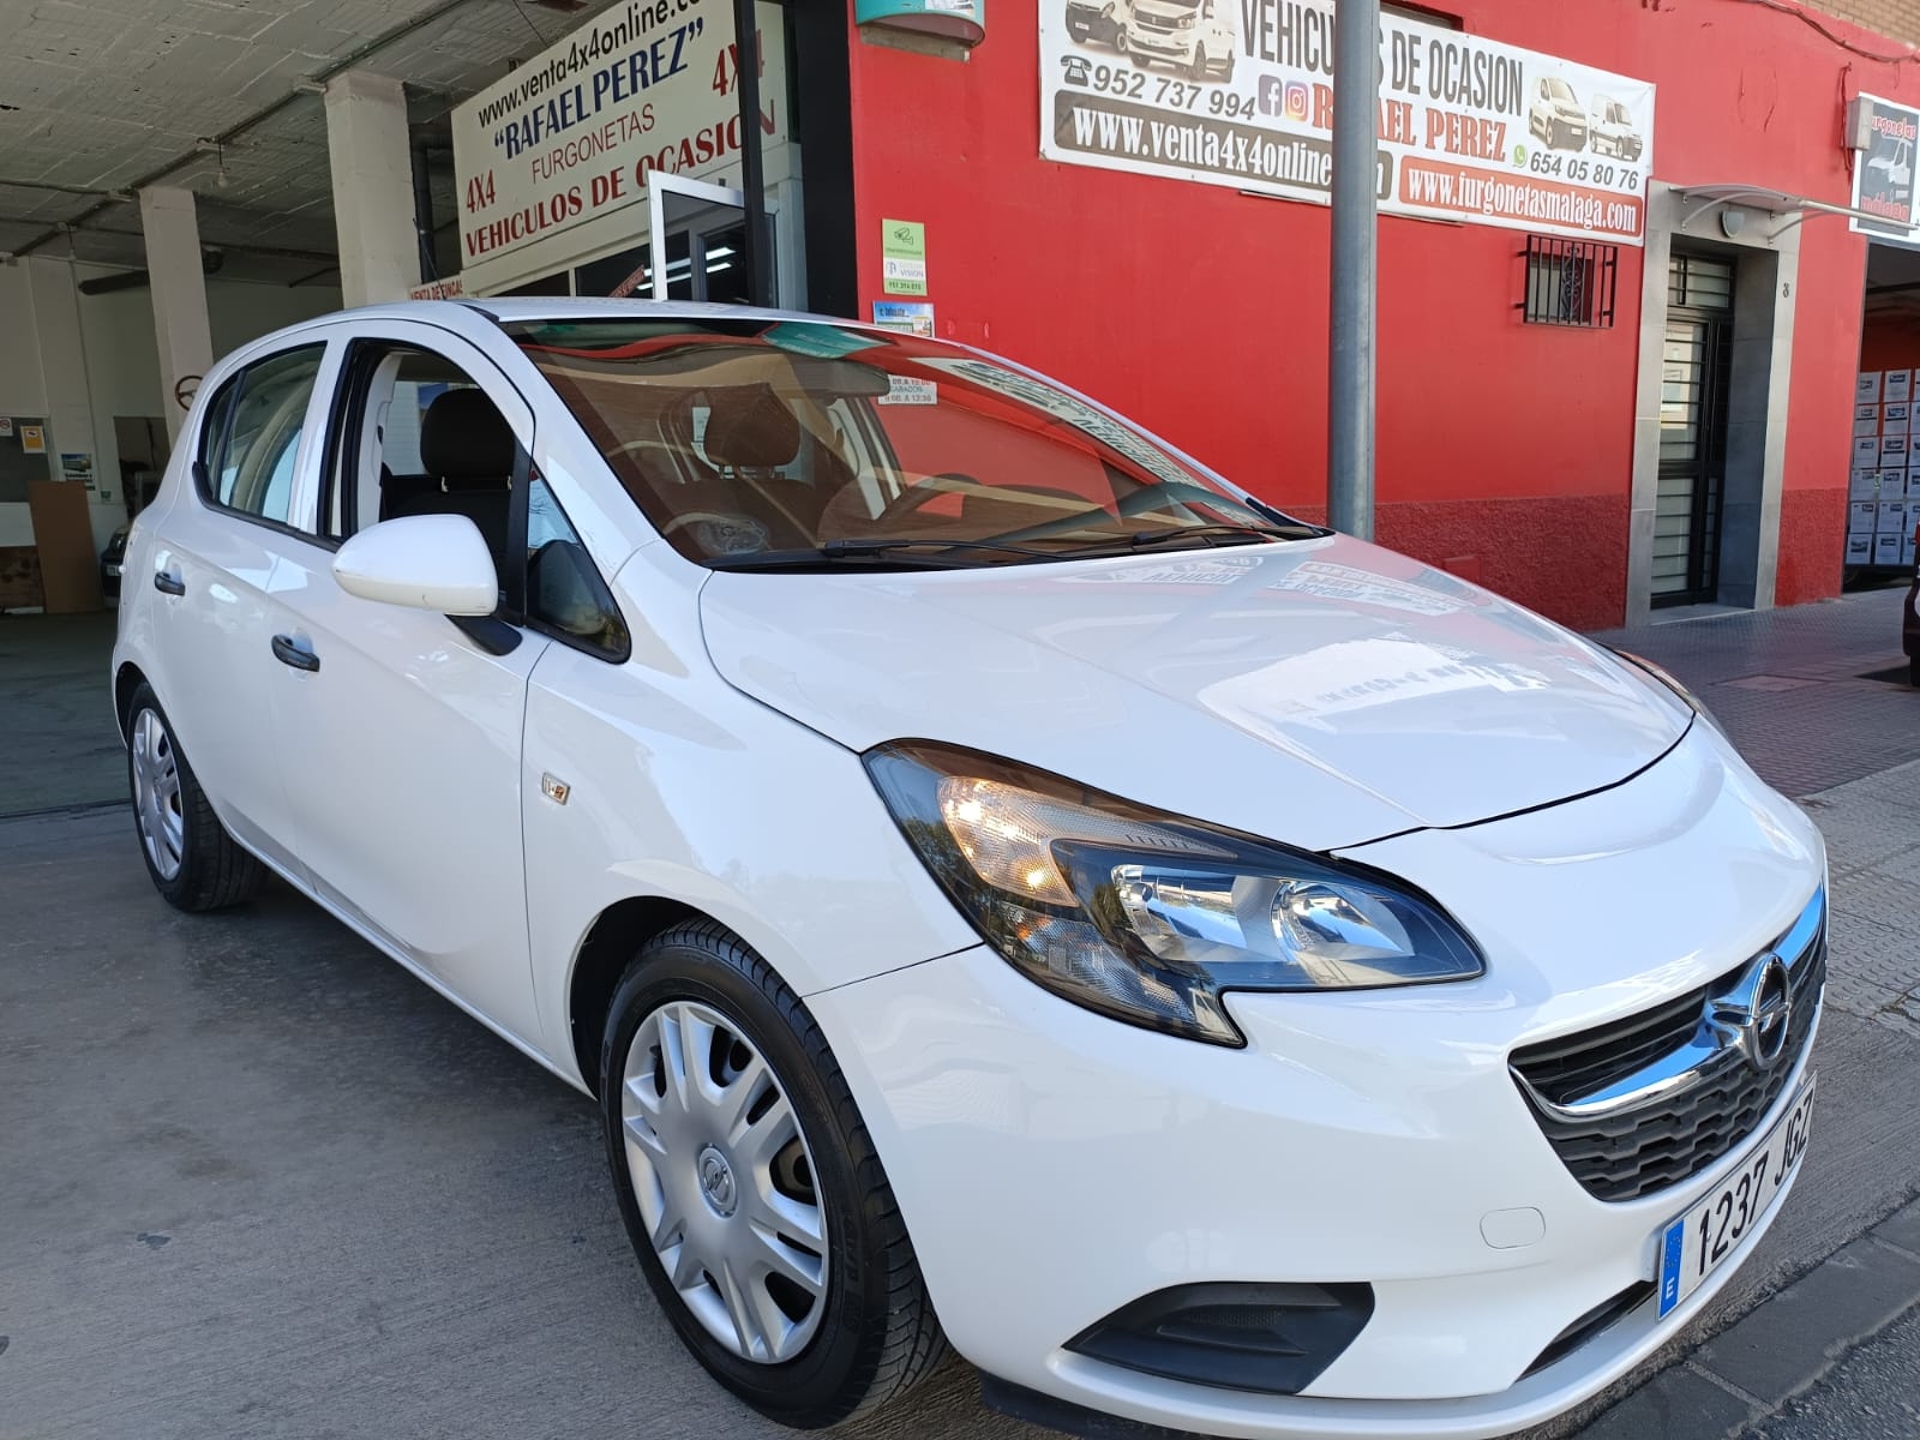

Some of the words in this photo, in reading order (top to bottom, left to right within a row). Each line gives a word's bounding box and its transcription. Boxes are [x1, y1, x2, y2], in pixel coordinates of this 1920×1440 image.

[1240, 0, 1384, 86] VEHICU
[1392, 30, 1422, 95] DE
[1428, 39, 1523, 117] OCASION
[1093, 65, 1146, 99] 952
[1156, 77, 1203, 110] 737
[1208, 89, 1256, 121] 994
[531, 103, 655, 184] FURGONETAS
[1425, 107, 1507, 162] PEREZ
[1871, 114, 1917, 140] urgonetas
[466, 169, 496, 214] 4X4
[1530, 151, 1561, 177] 654
[1567, 161, 1588, 181] 05
[1593, 165, 1614, 186] 80
[1619, 169, 1639, 191] 76
[466, 186, 583, 257] VEHICULOS
[592, 166, 627, 208] DE
[1408, 167, 1636, 232] www.furgonetasmalaga.com
[1699, 1150, 1769, 1277] 1237
[1774, 1088, 1814, 1186] JGZ
[1666, 1276, 1675, 1298] E
